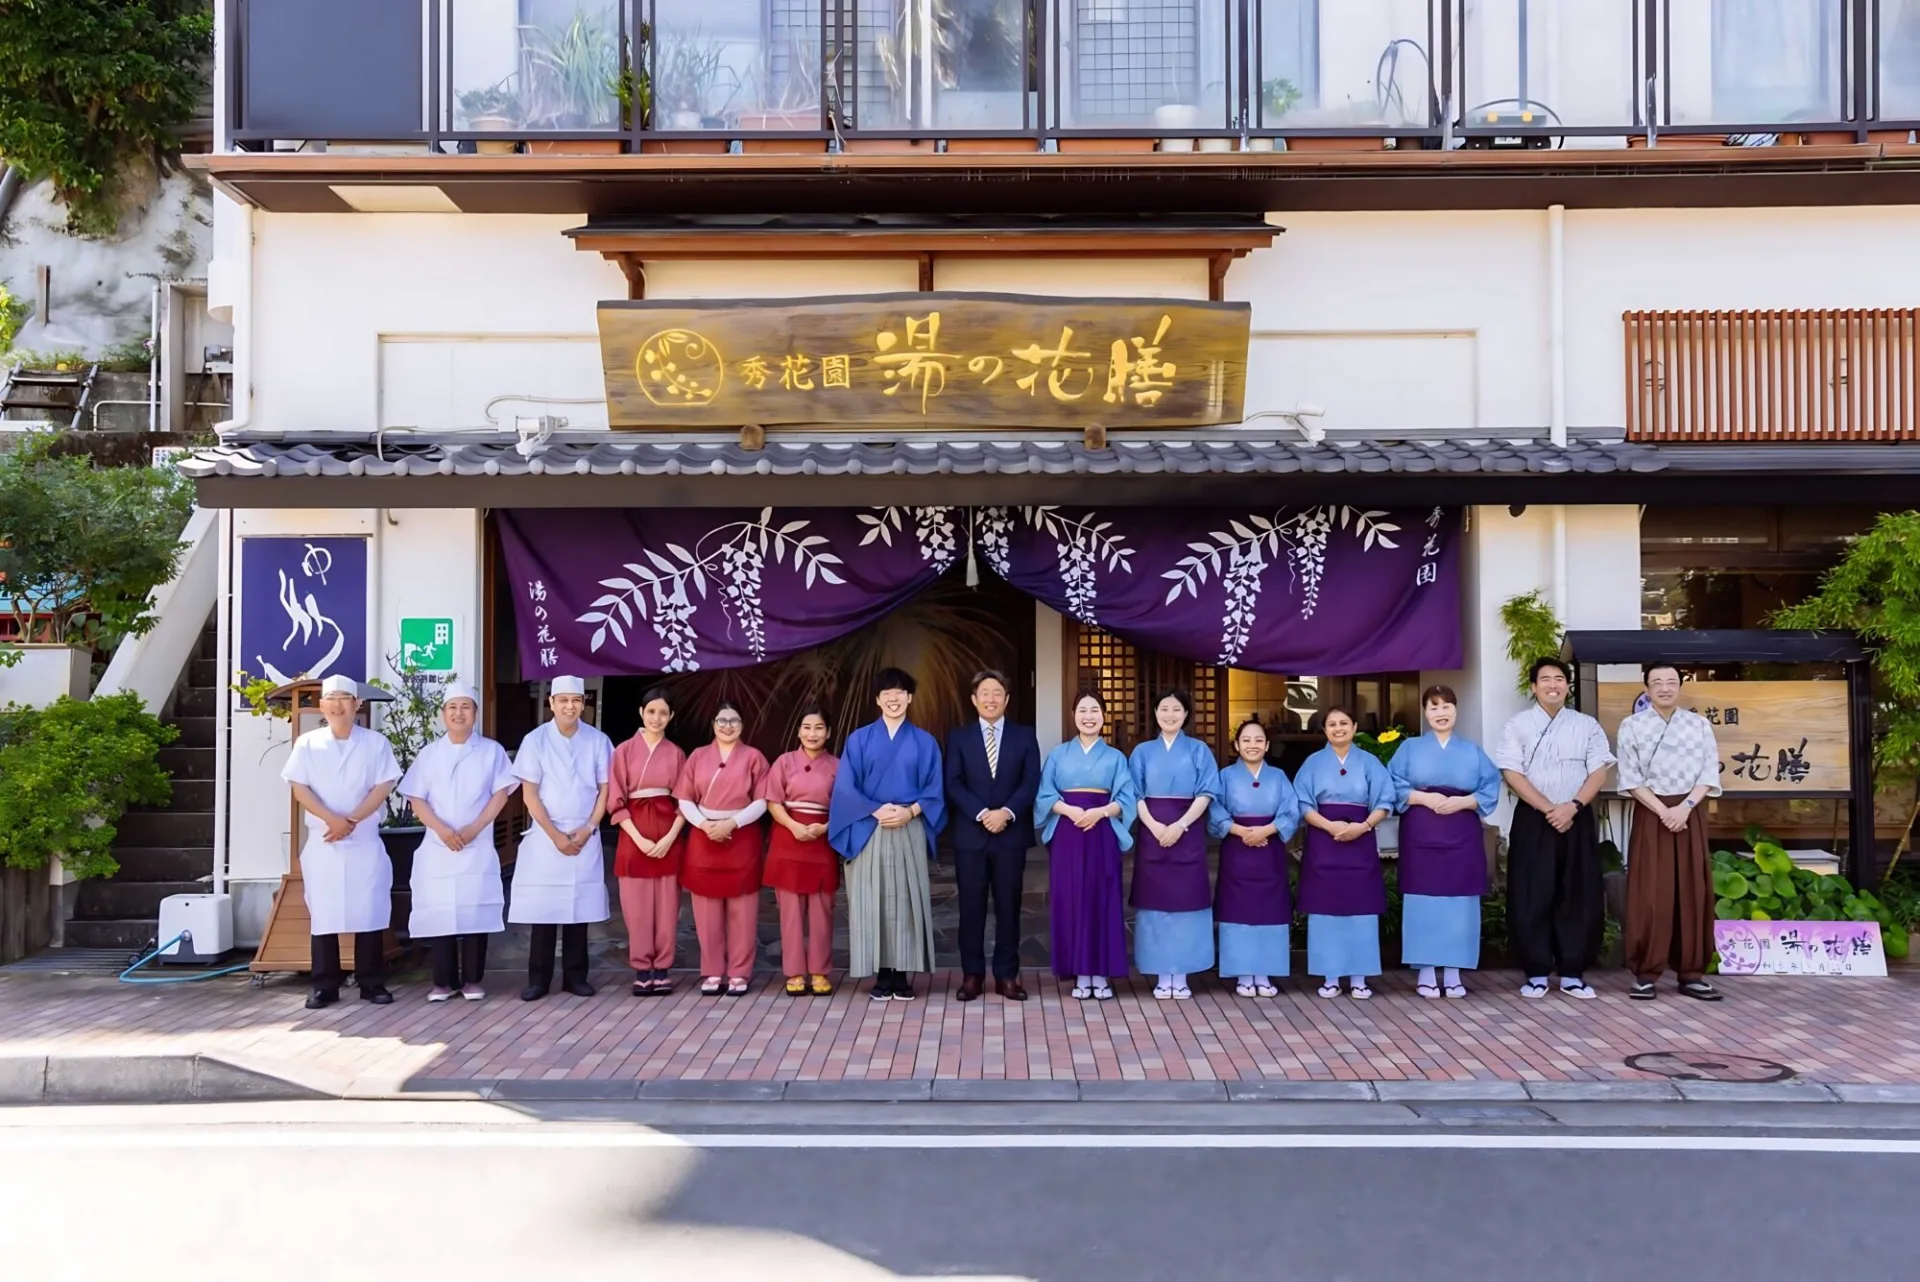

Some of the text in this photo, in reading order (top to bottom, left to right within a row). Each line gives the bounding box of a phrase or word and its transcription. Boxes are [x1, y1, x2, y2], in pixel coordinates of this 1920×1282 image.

[740, 312, 1176, 415] 秀花園 湯の花膳
[1416, 506, 1444, 587] 秀花園
[528, 580, 559, 668] 湯の花膳
